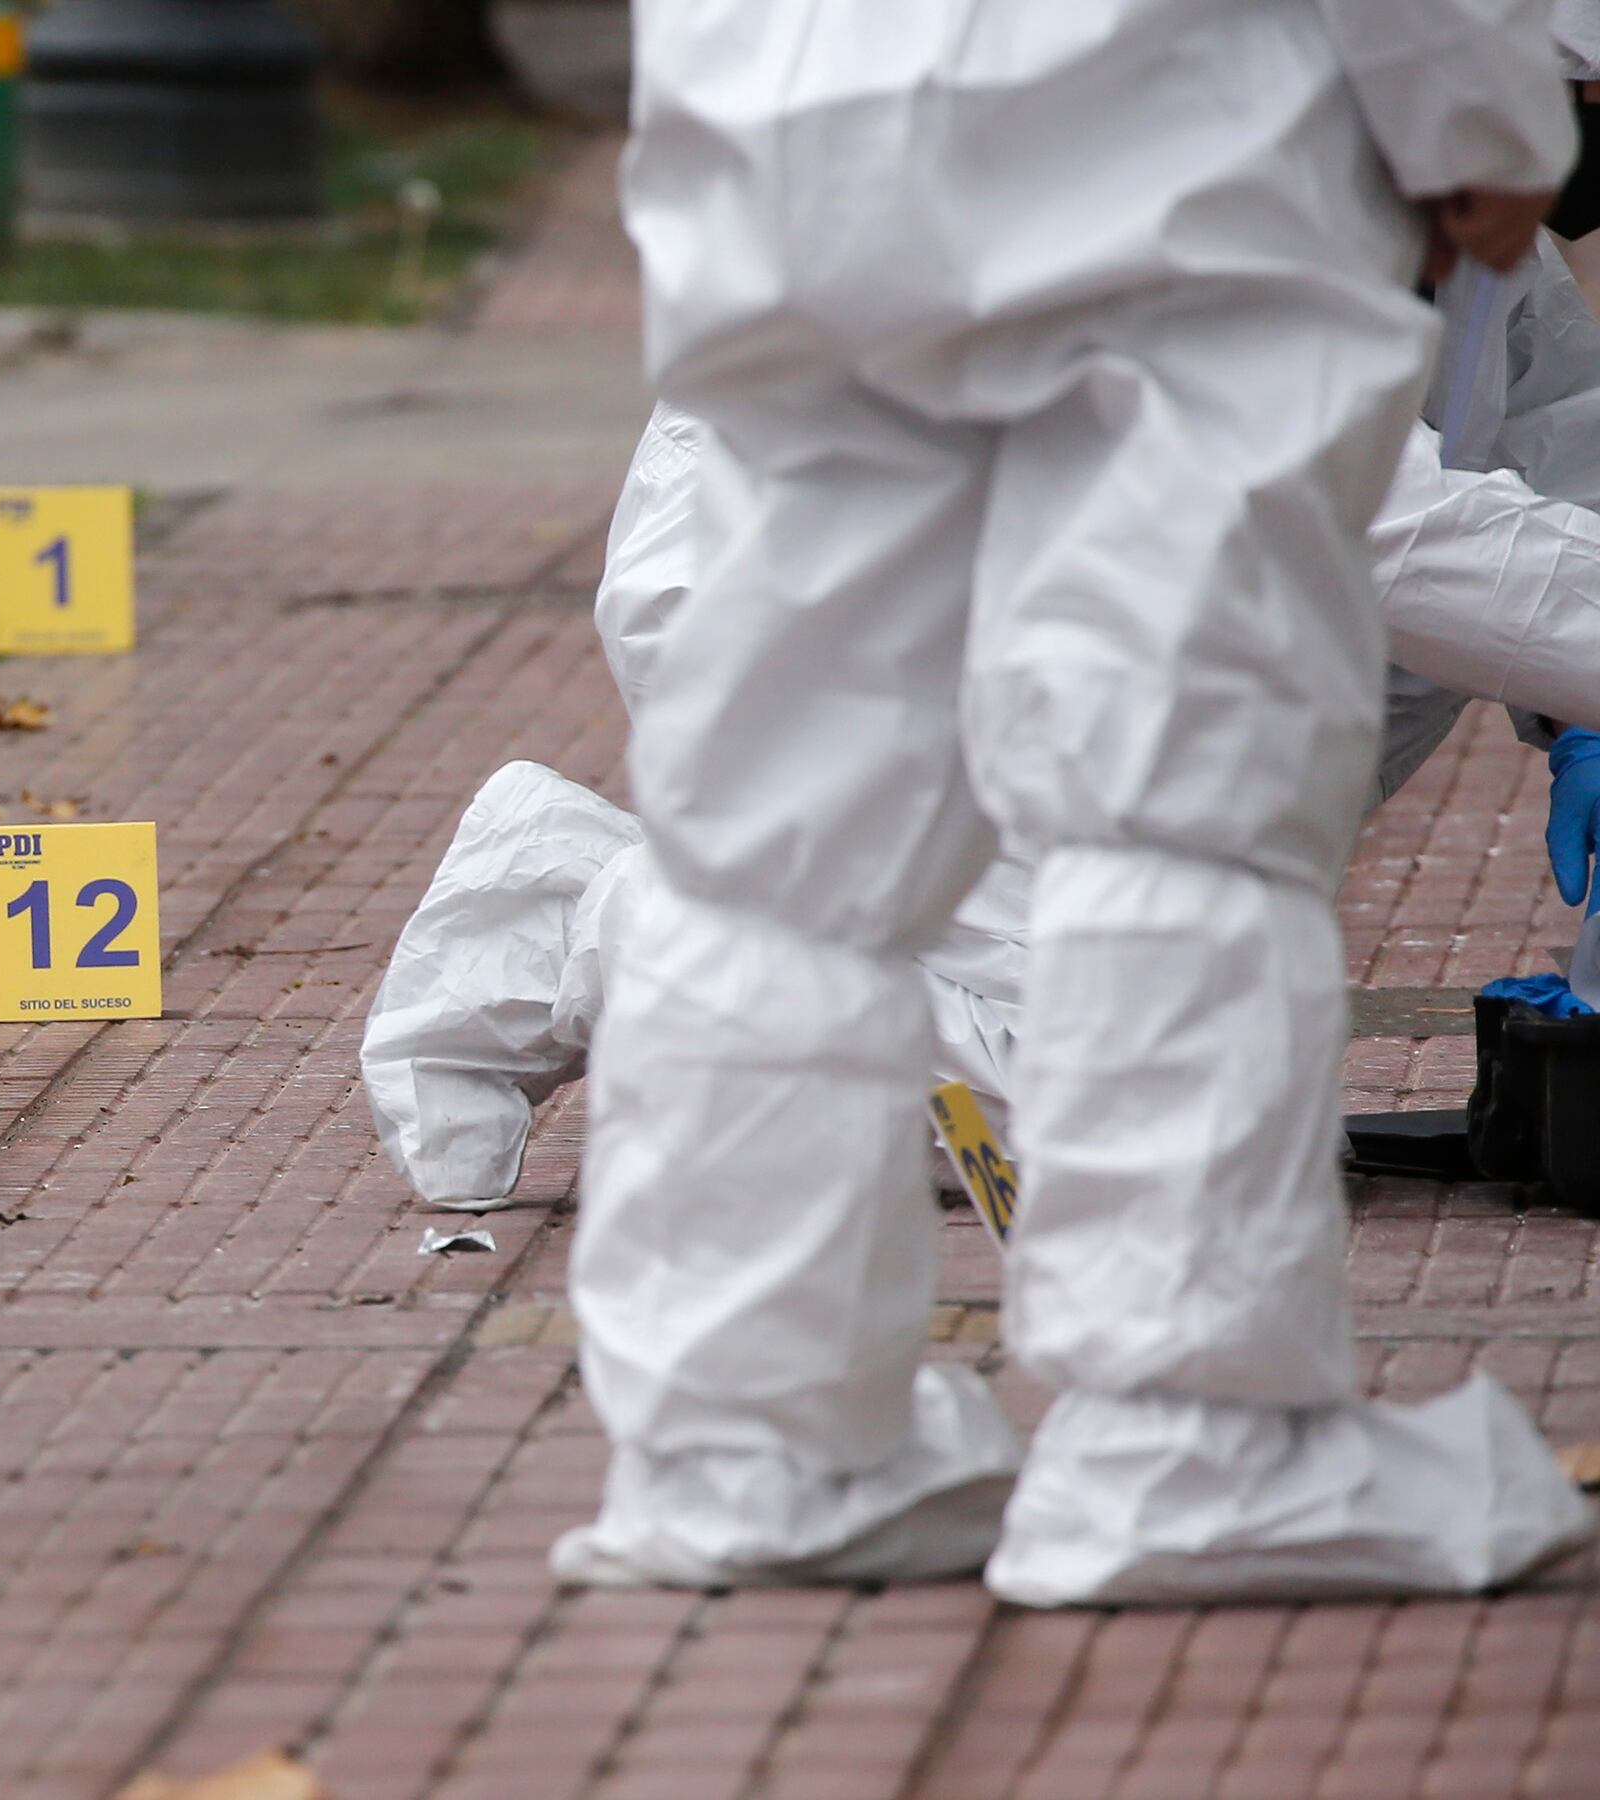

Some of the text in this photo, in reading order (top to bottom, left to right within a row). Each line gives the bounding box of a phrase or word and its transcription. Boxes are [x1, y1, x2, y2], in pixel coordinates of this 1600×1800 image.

[36, 533, 71, 606] 1
[7, 878, 140, 969] 12
[19, 997, 132, 1011] SITIO DEL SUCESO
